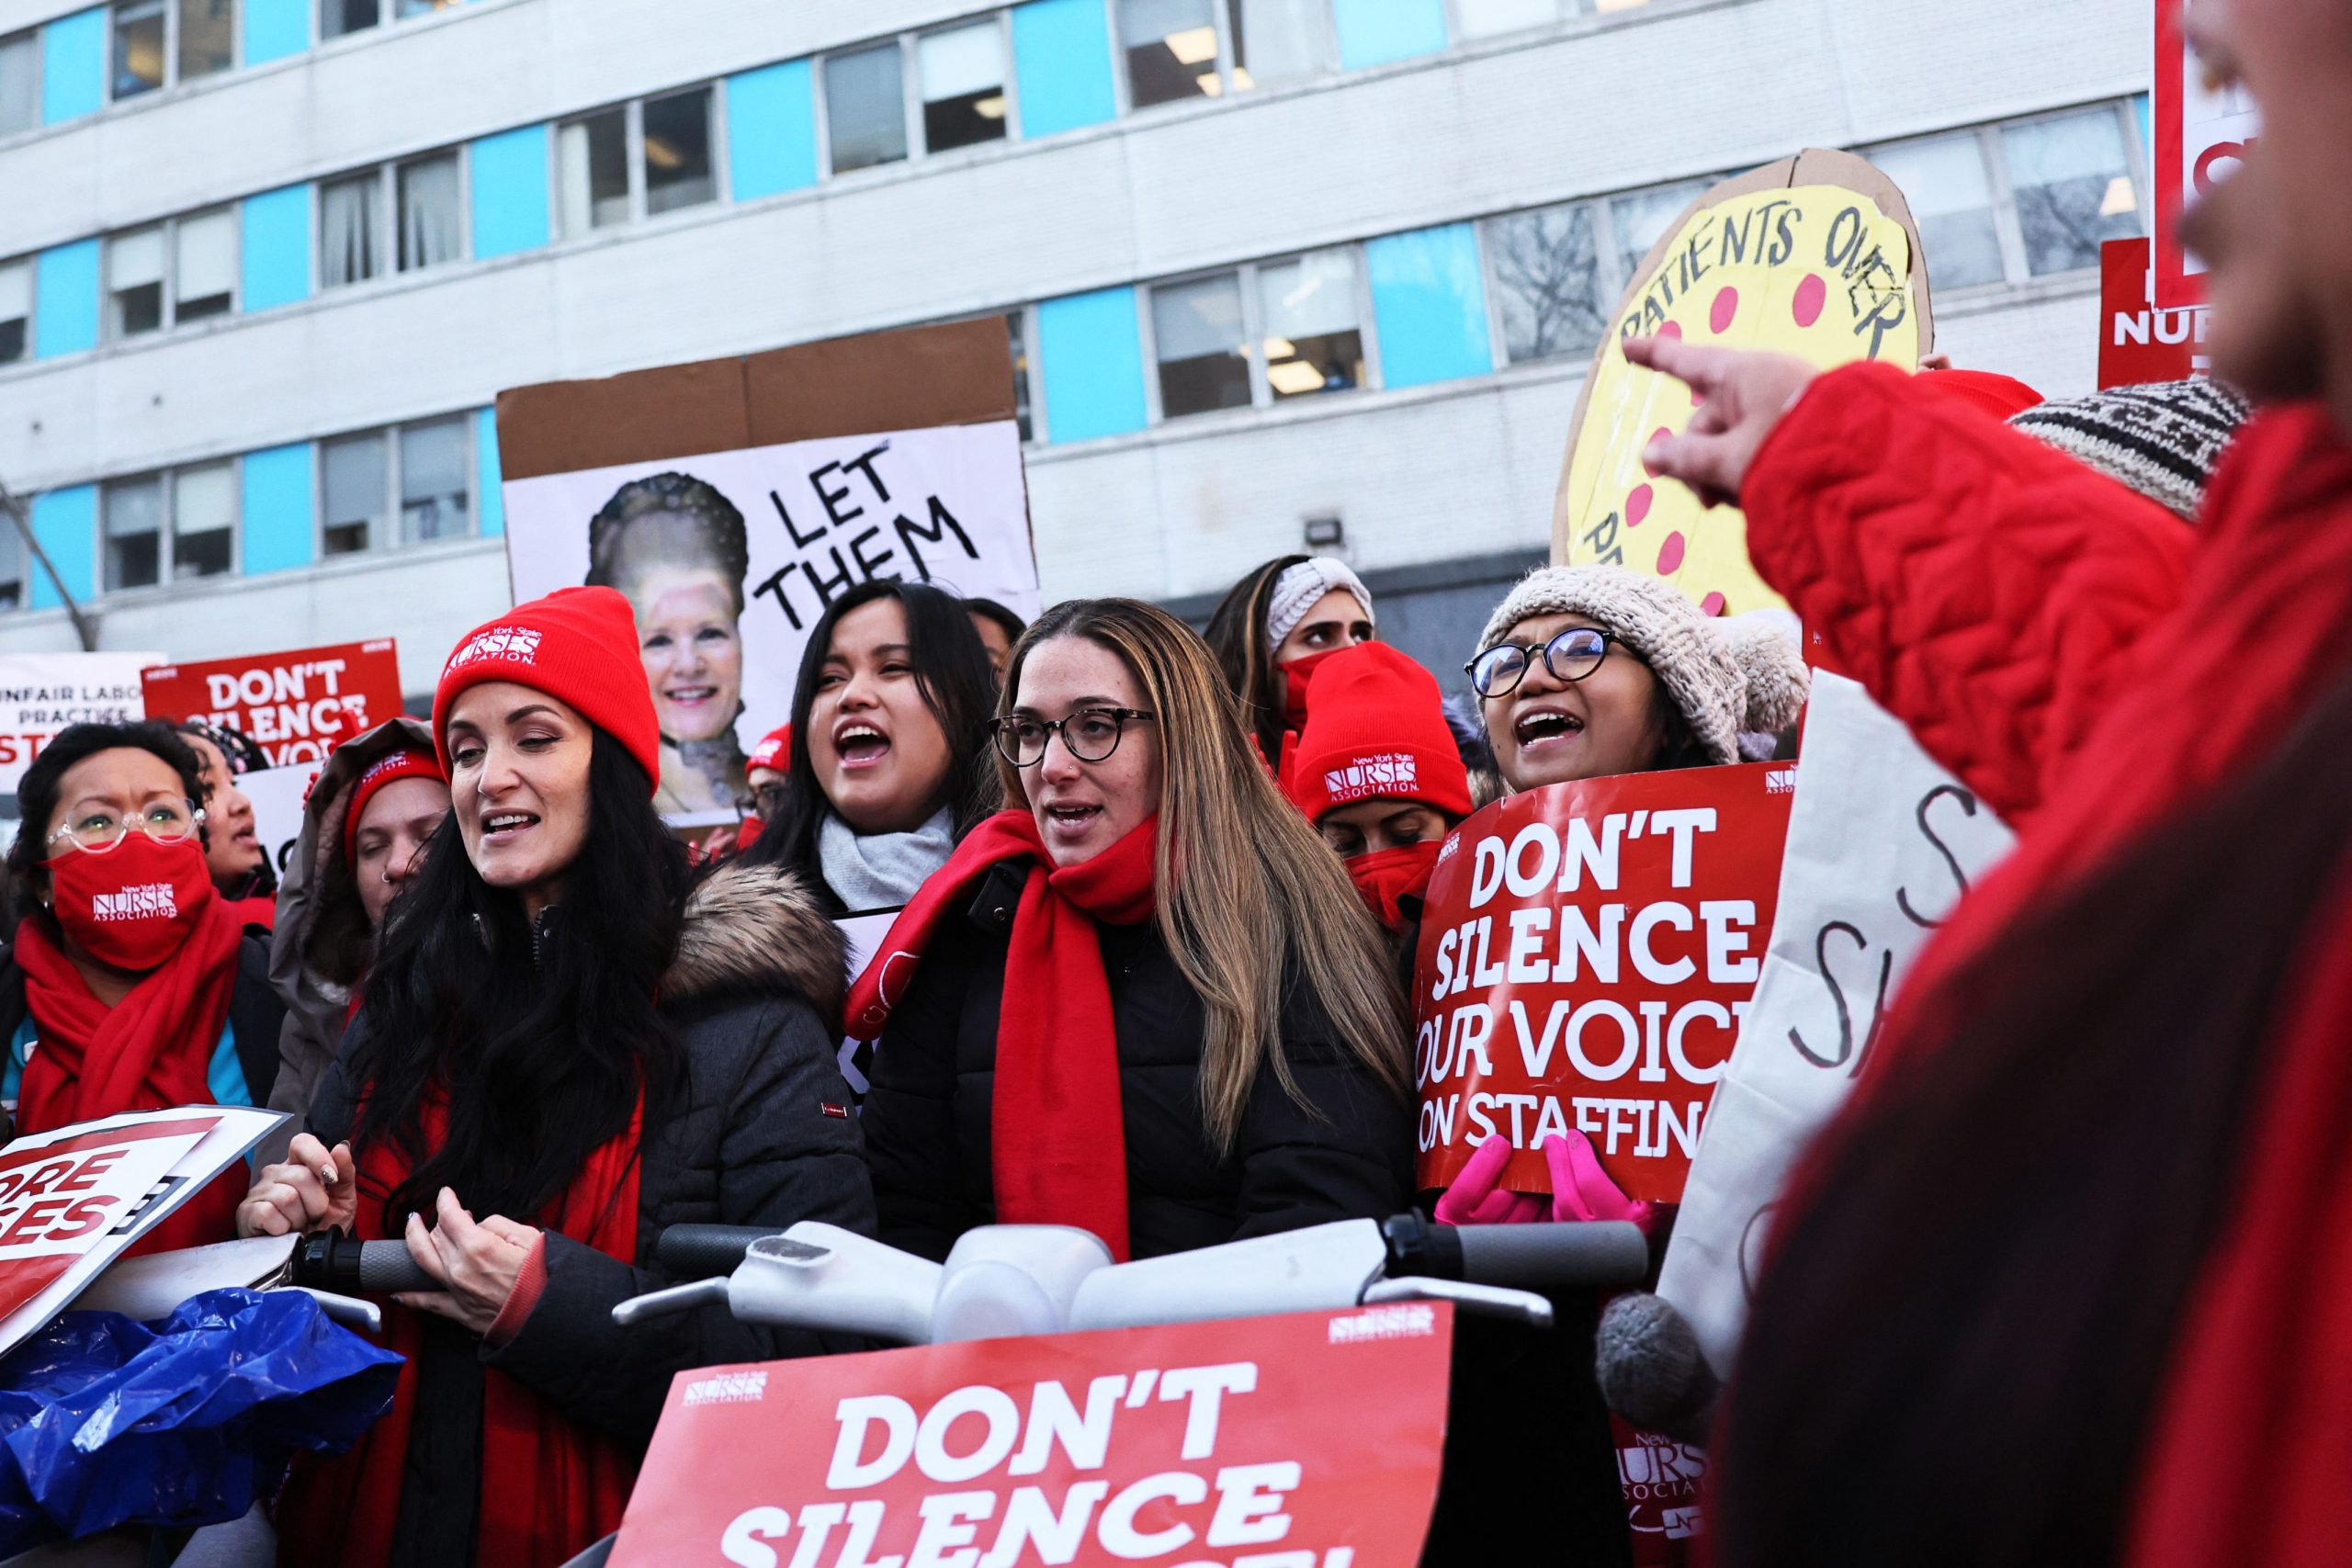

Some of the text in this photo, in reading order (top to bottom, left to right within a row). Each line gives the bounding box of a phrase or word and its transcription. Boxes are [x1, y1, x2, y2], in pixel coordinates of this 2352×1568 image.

[1621, 199, 1802, 340] PATIENTS
[770, 439, 890, 549] LET
[752, 495, 980, 630] THEM
[0, 687, 74, 704] NFAIR
[206, 659, 346, 710] DON'T
[1324, 761, 1416, 794] NURSES
[1352, 752, 1415, 766] New York State
[121, 886, 140, 894] New
[1469, 807, 1717, 908] DON'T
[93, 889, 174, 915] NURSES
[94, 902, 177, 922] ASSOCIATION
[1431, 899, 1759, 1002] SILENCE
[1415, 1003, 1494, 1093] OUR
[1419, 1091, 1705, 1160] ON STAFFIN
[826, 1361, 1259, 1490] DON'T
[720, 1461, 1303, 1568] SILENCE
